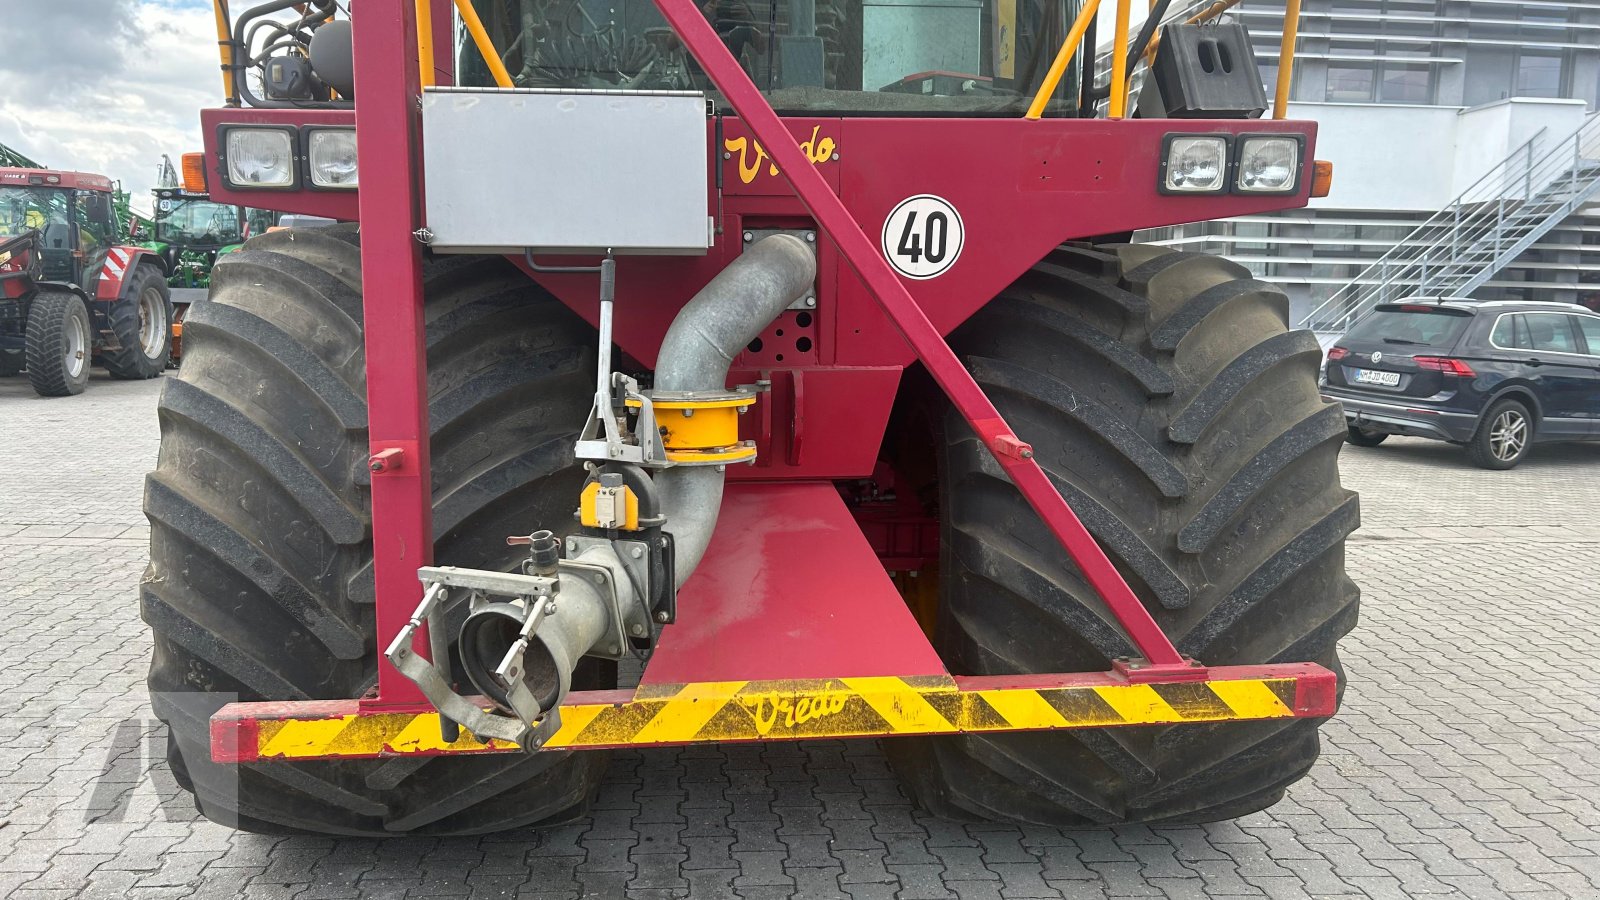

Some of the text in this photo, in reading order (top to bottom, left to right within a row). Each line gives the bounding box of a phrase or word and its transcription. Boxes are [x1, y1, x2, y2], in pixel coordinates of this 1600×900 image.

[161, 201, 169, 209] 50
[897, 211, 948, 264] 40
[1382, 373, 1398, 383] 4000
[742, 682, 849, 734] Vredo
